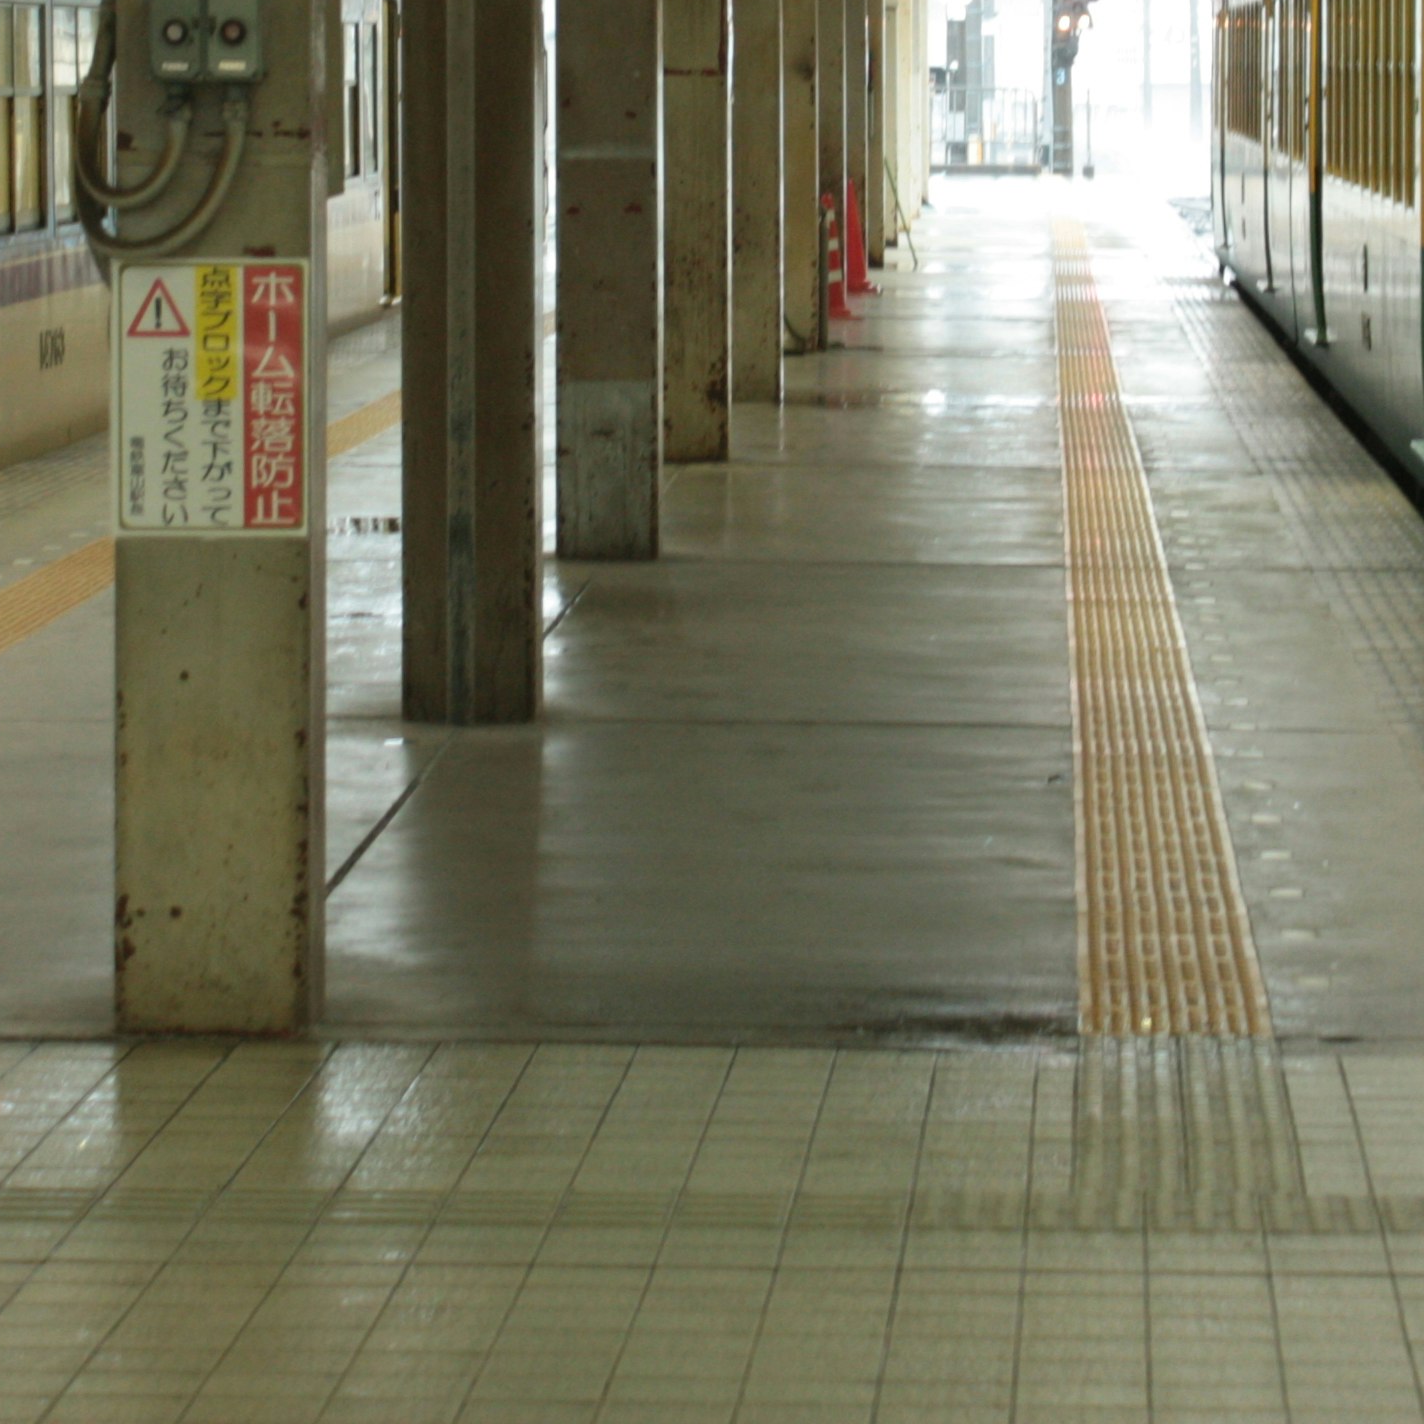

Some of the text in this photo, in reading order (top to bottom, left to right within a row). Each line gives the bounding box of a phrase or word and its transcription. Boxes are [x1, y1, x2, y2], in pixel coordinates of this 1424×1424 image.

[162, 348, 189, 526] お待ちください
[200, 266, 232, 526] 点字ブロックまで下がって
[251, 272, 296, 524] ホーム転落防止
